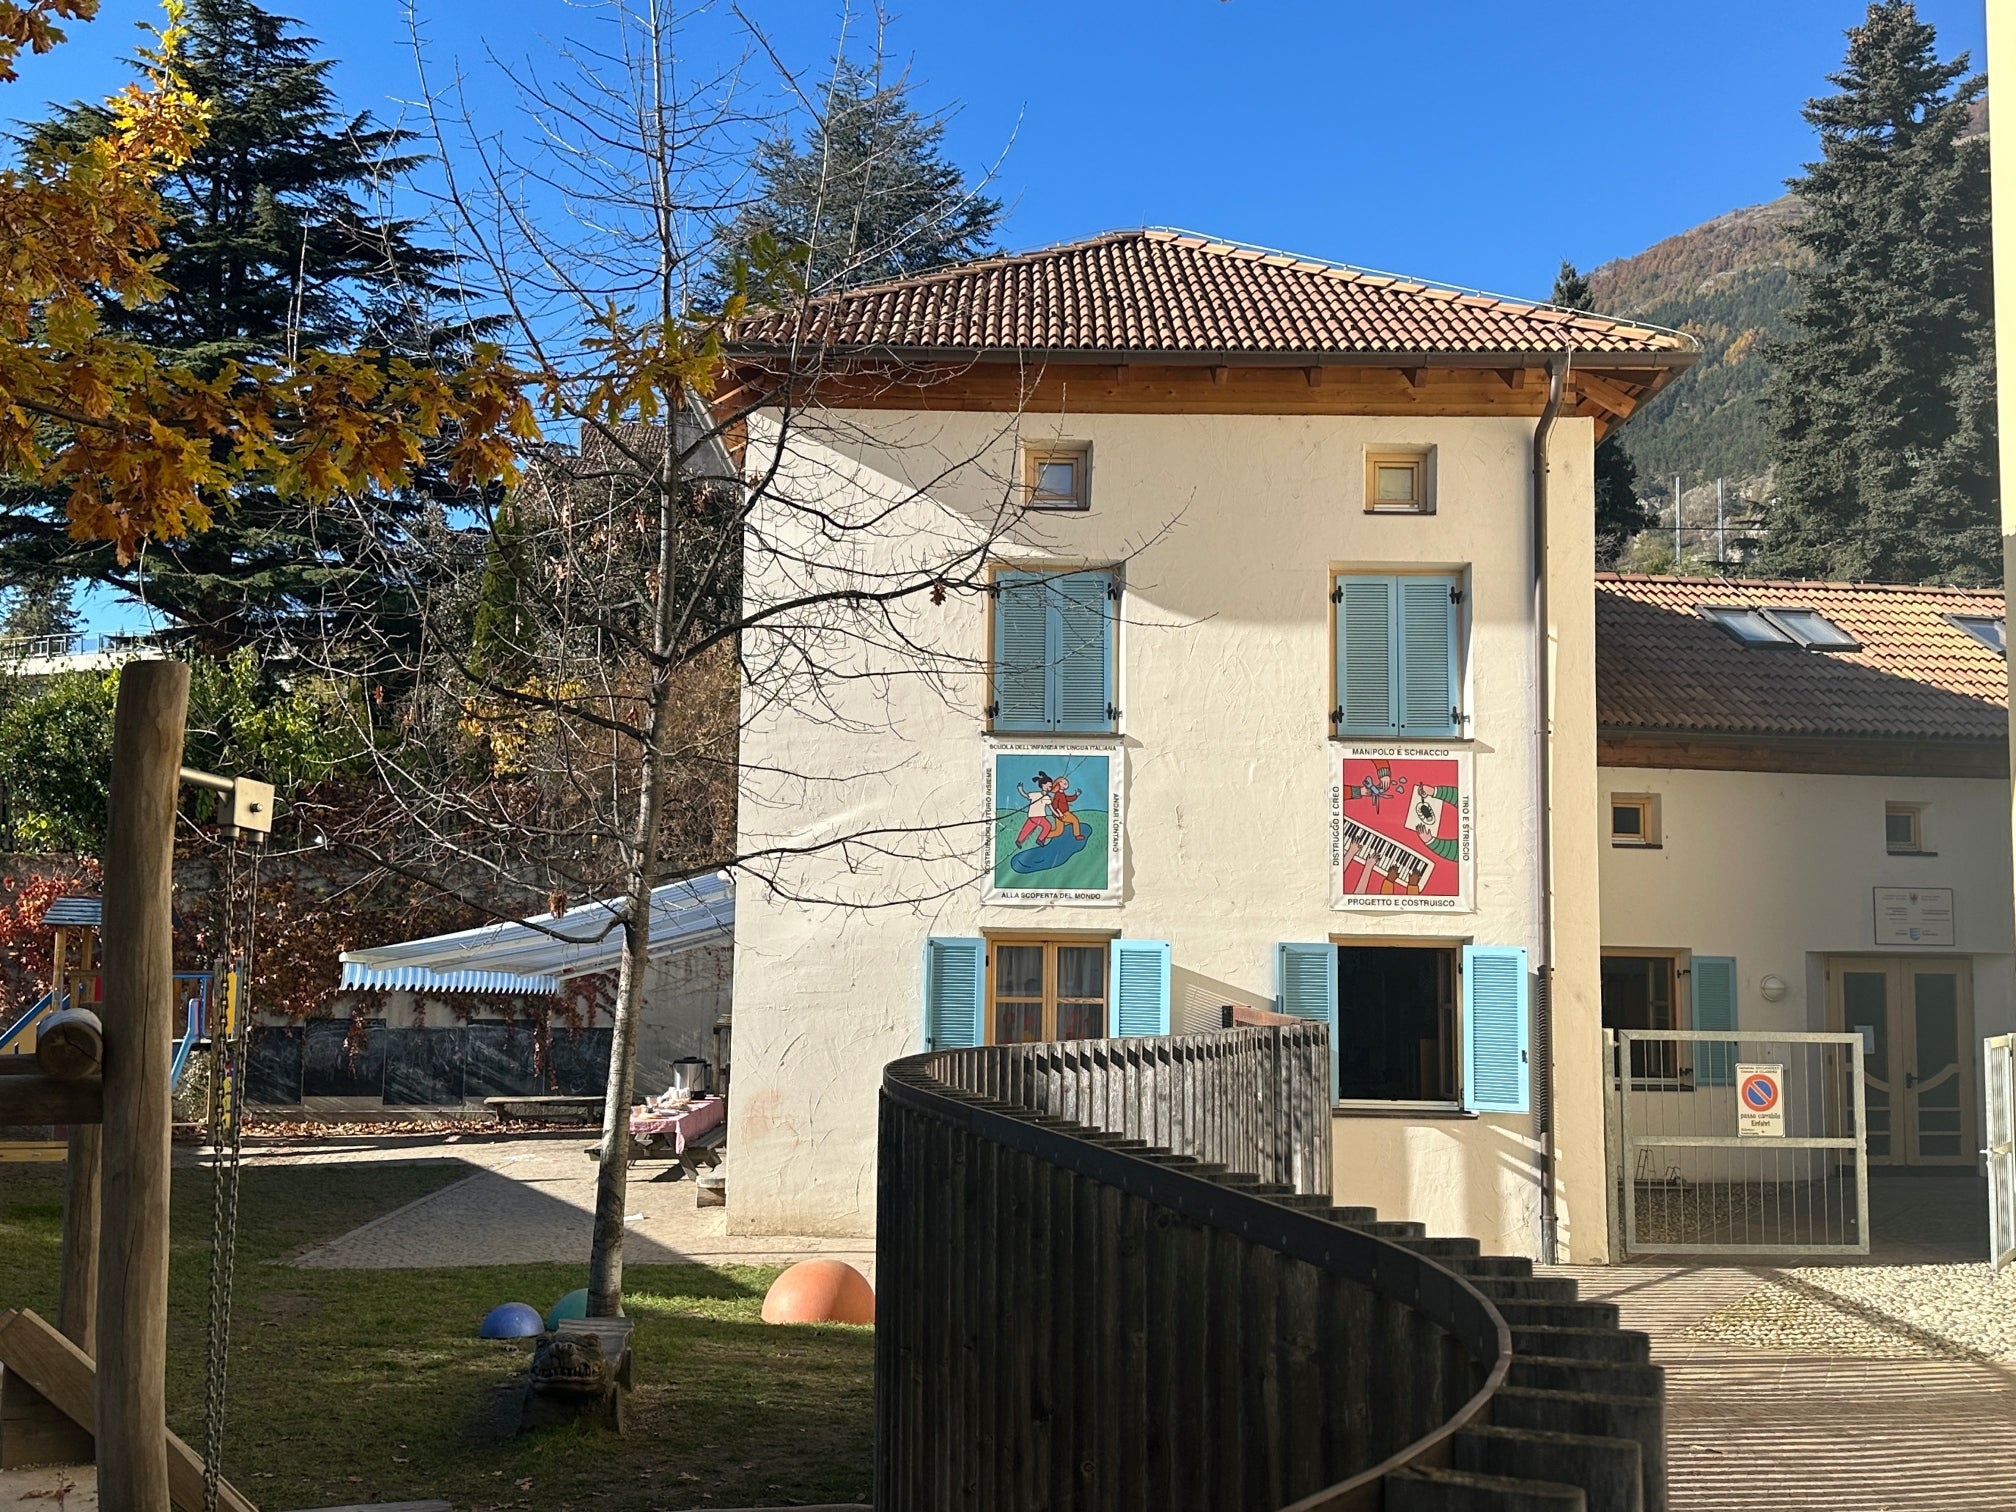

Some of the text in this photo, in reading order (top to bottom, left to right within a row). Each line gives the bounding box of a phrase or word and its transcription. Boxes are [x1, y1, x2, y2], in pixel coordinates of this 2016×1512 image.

[1352, 748, 1395, 756] MANIPOLO
[1404, 748, 1449, 756] SCHIACCIO
[1332, 786, 1340, 809] CREO
[1462, 795, 1470, 814] TIRO
[1332, 819, 1340, 866] DISTRUGGO
[1462, 823, 1470, 861] STRISCIO
[1347, 898, 1392, 906] PROGETTO
[1401, 899, 1455, 907] COSTRUISCO
